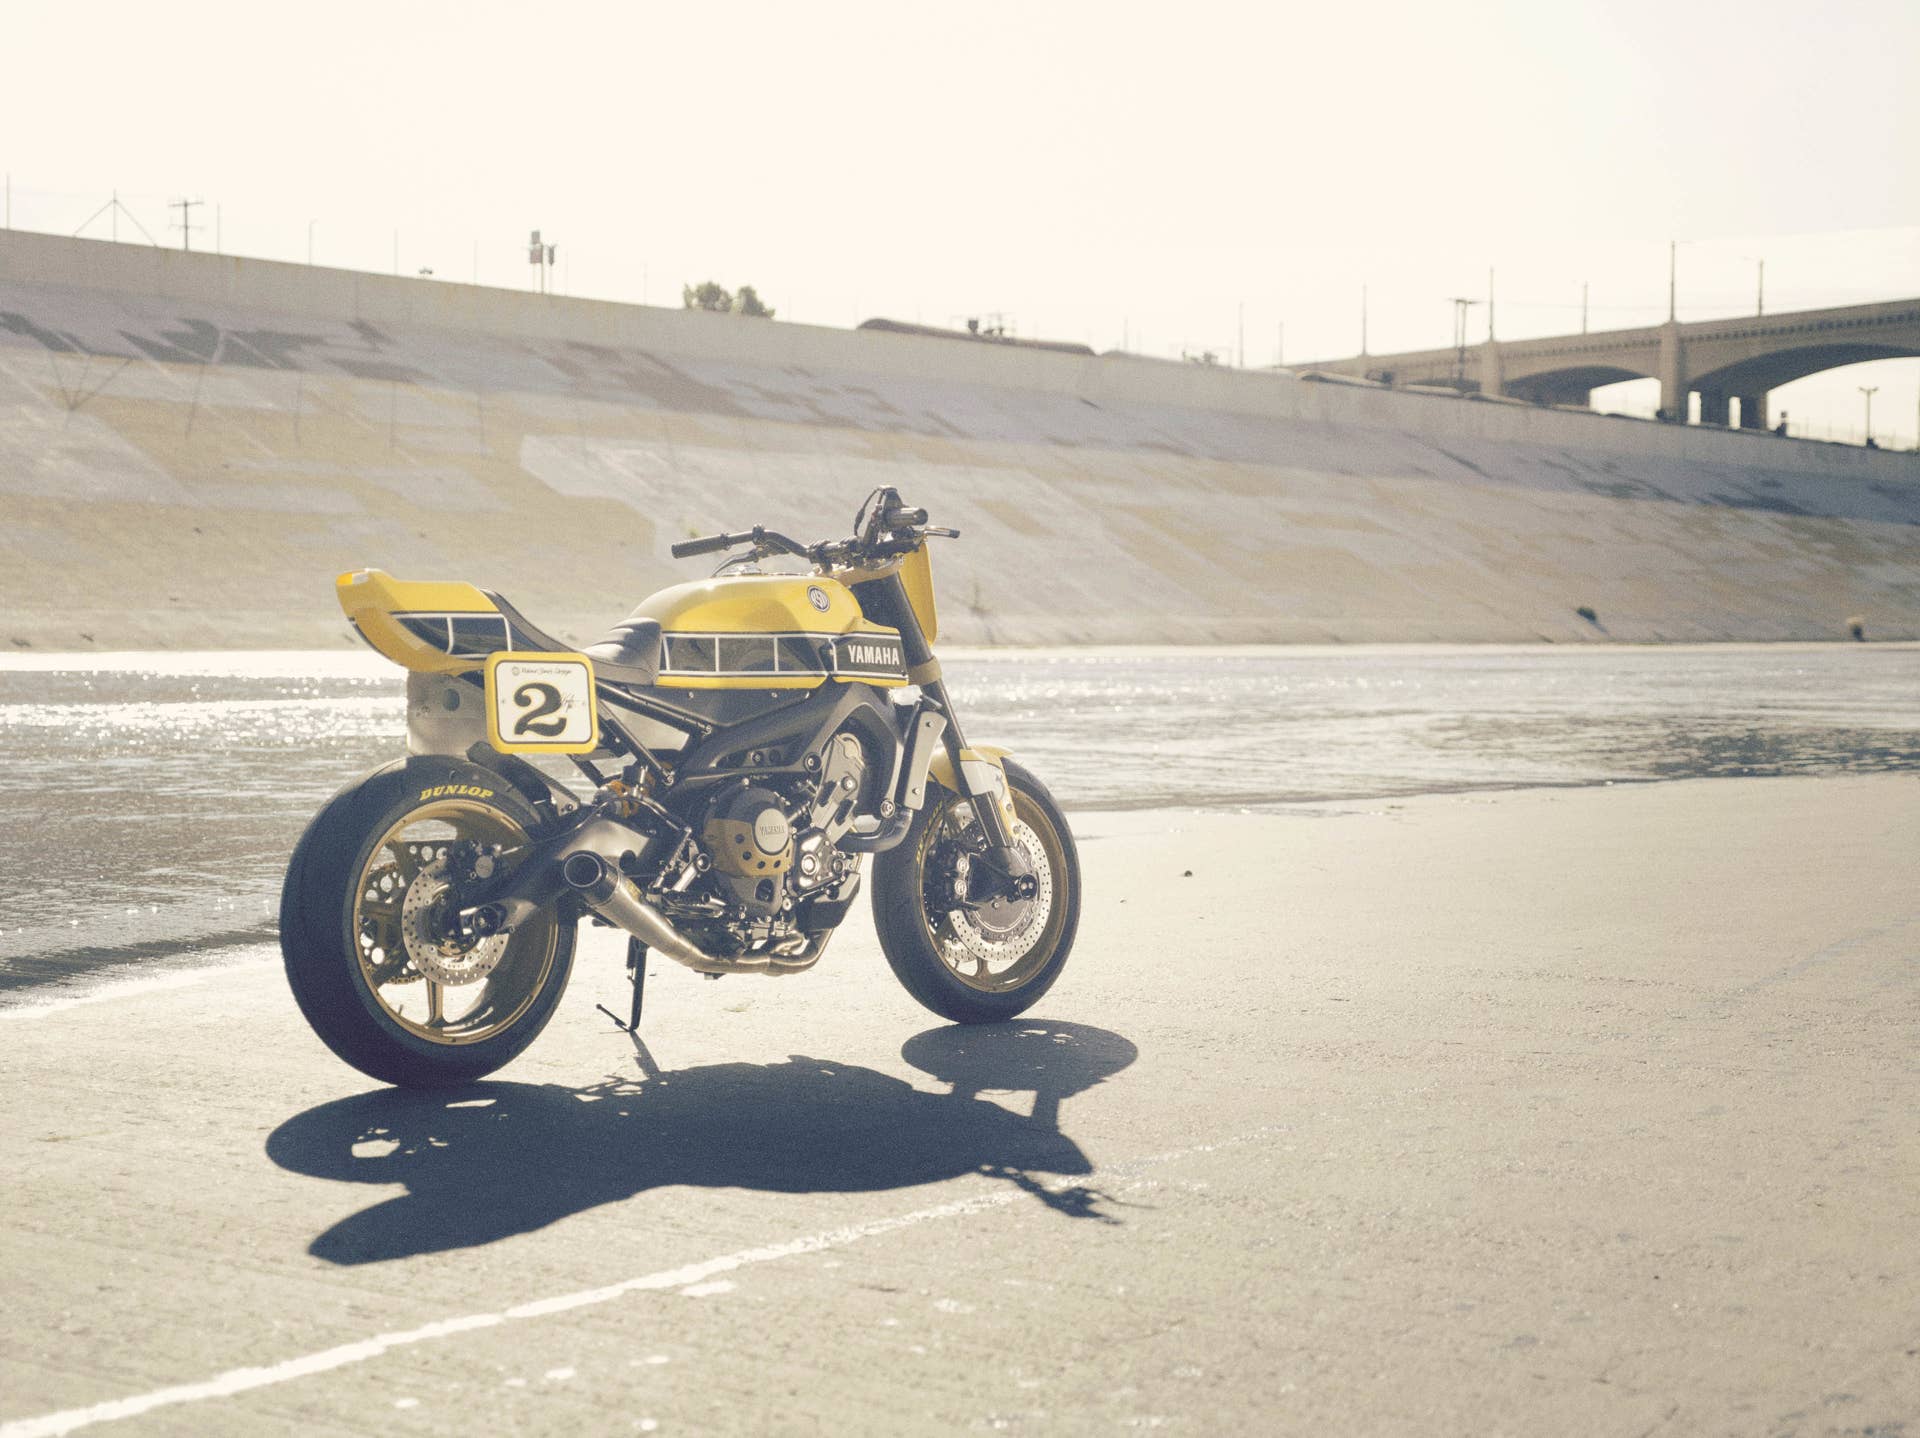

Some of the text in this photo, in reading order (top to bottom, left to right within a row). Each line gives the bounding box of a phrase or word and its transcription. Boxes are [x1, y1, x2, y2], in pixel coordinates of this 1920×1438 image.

[848, 644, 900, 665] YAMAHA
[514, 682, 567, 737] 2
[419, 784, 494, 801] DUNLOP
